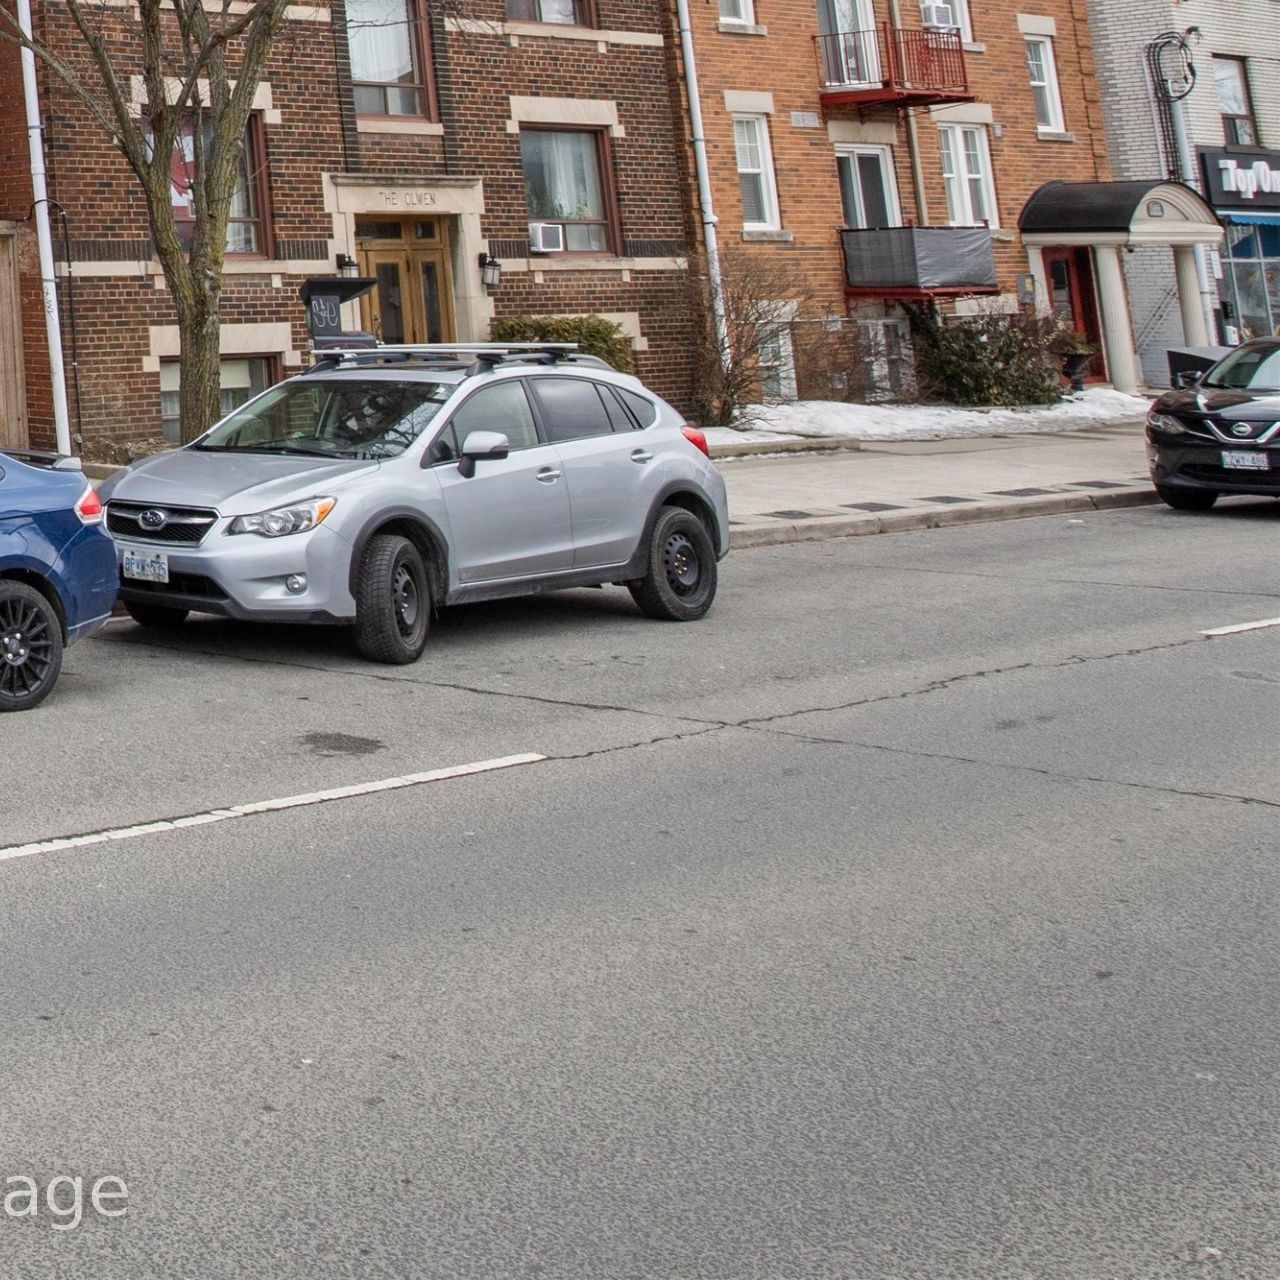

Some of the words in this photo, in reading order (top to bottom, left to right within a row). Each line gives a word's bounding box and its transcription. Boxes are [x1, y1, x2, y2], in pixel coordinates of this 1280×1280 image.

[1219, 160, 1257, 199] Top
[378, 191, 398, 206] THE
[405, 192, 437, 206] OLWEN
